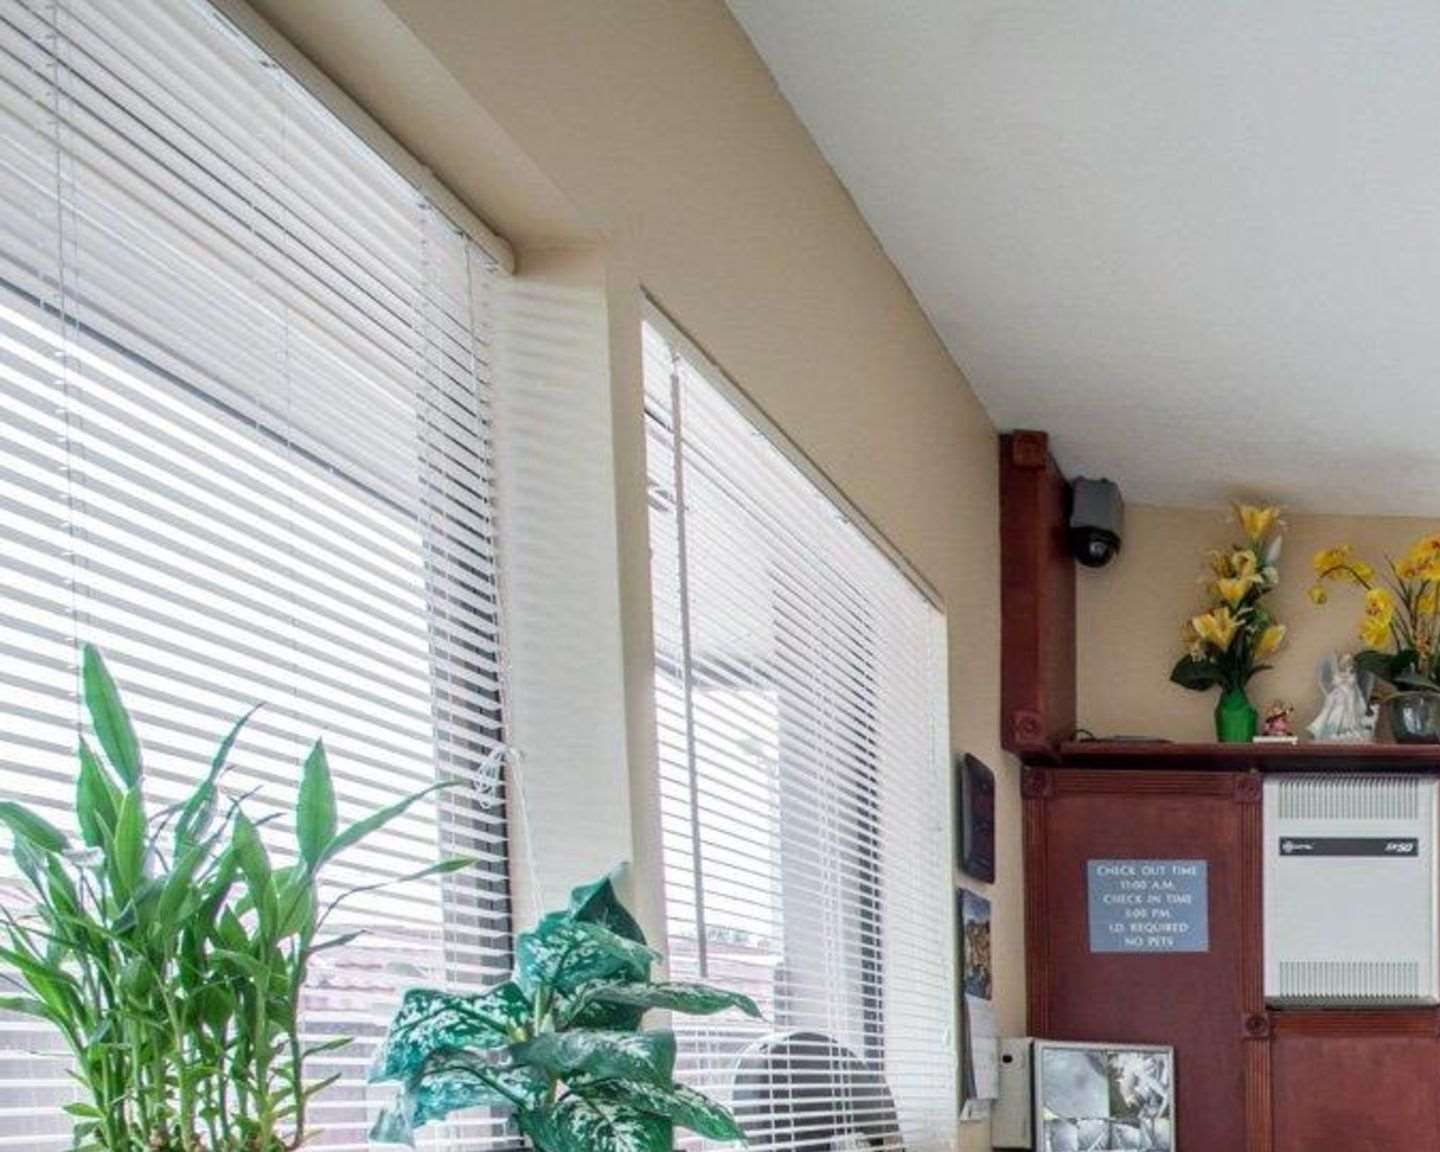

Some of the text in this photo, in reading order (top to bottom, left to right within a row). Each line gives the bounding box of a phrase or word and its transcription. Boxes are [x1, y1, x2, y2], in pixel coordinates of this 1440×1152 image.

[1097, 866, 1197, 875] CHECK OUT TIME
[1103, 894, 1192, 904] CHECK IN TIME
[1131, 922, 1190, 932] REQUIRED
[1125, 937, 1174, 946] NO PETS
